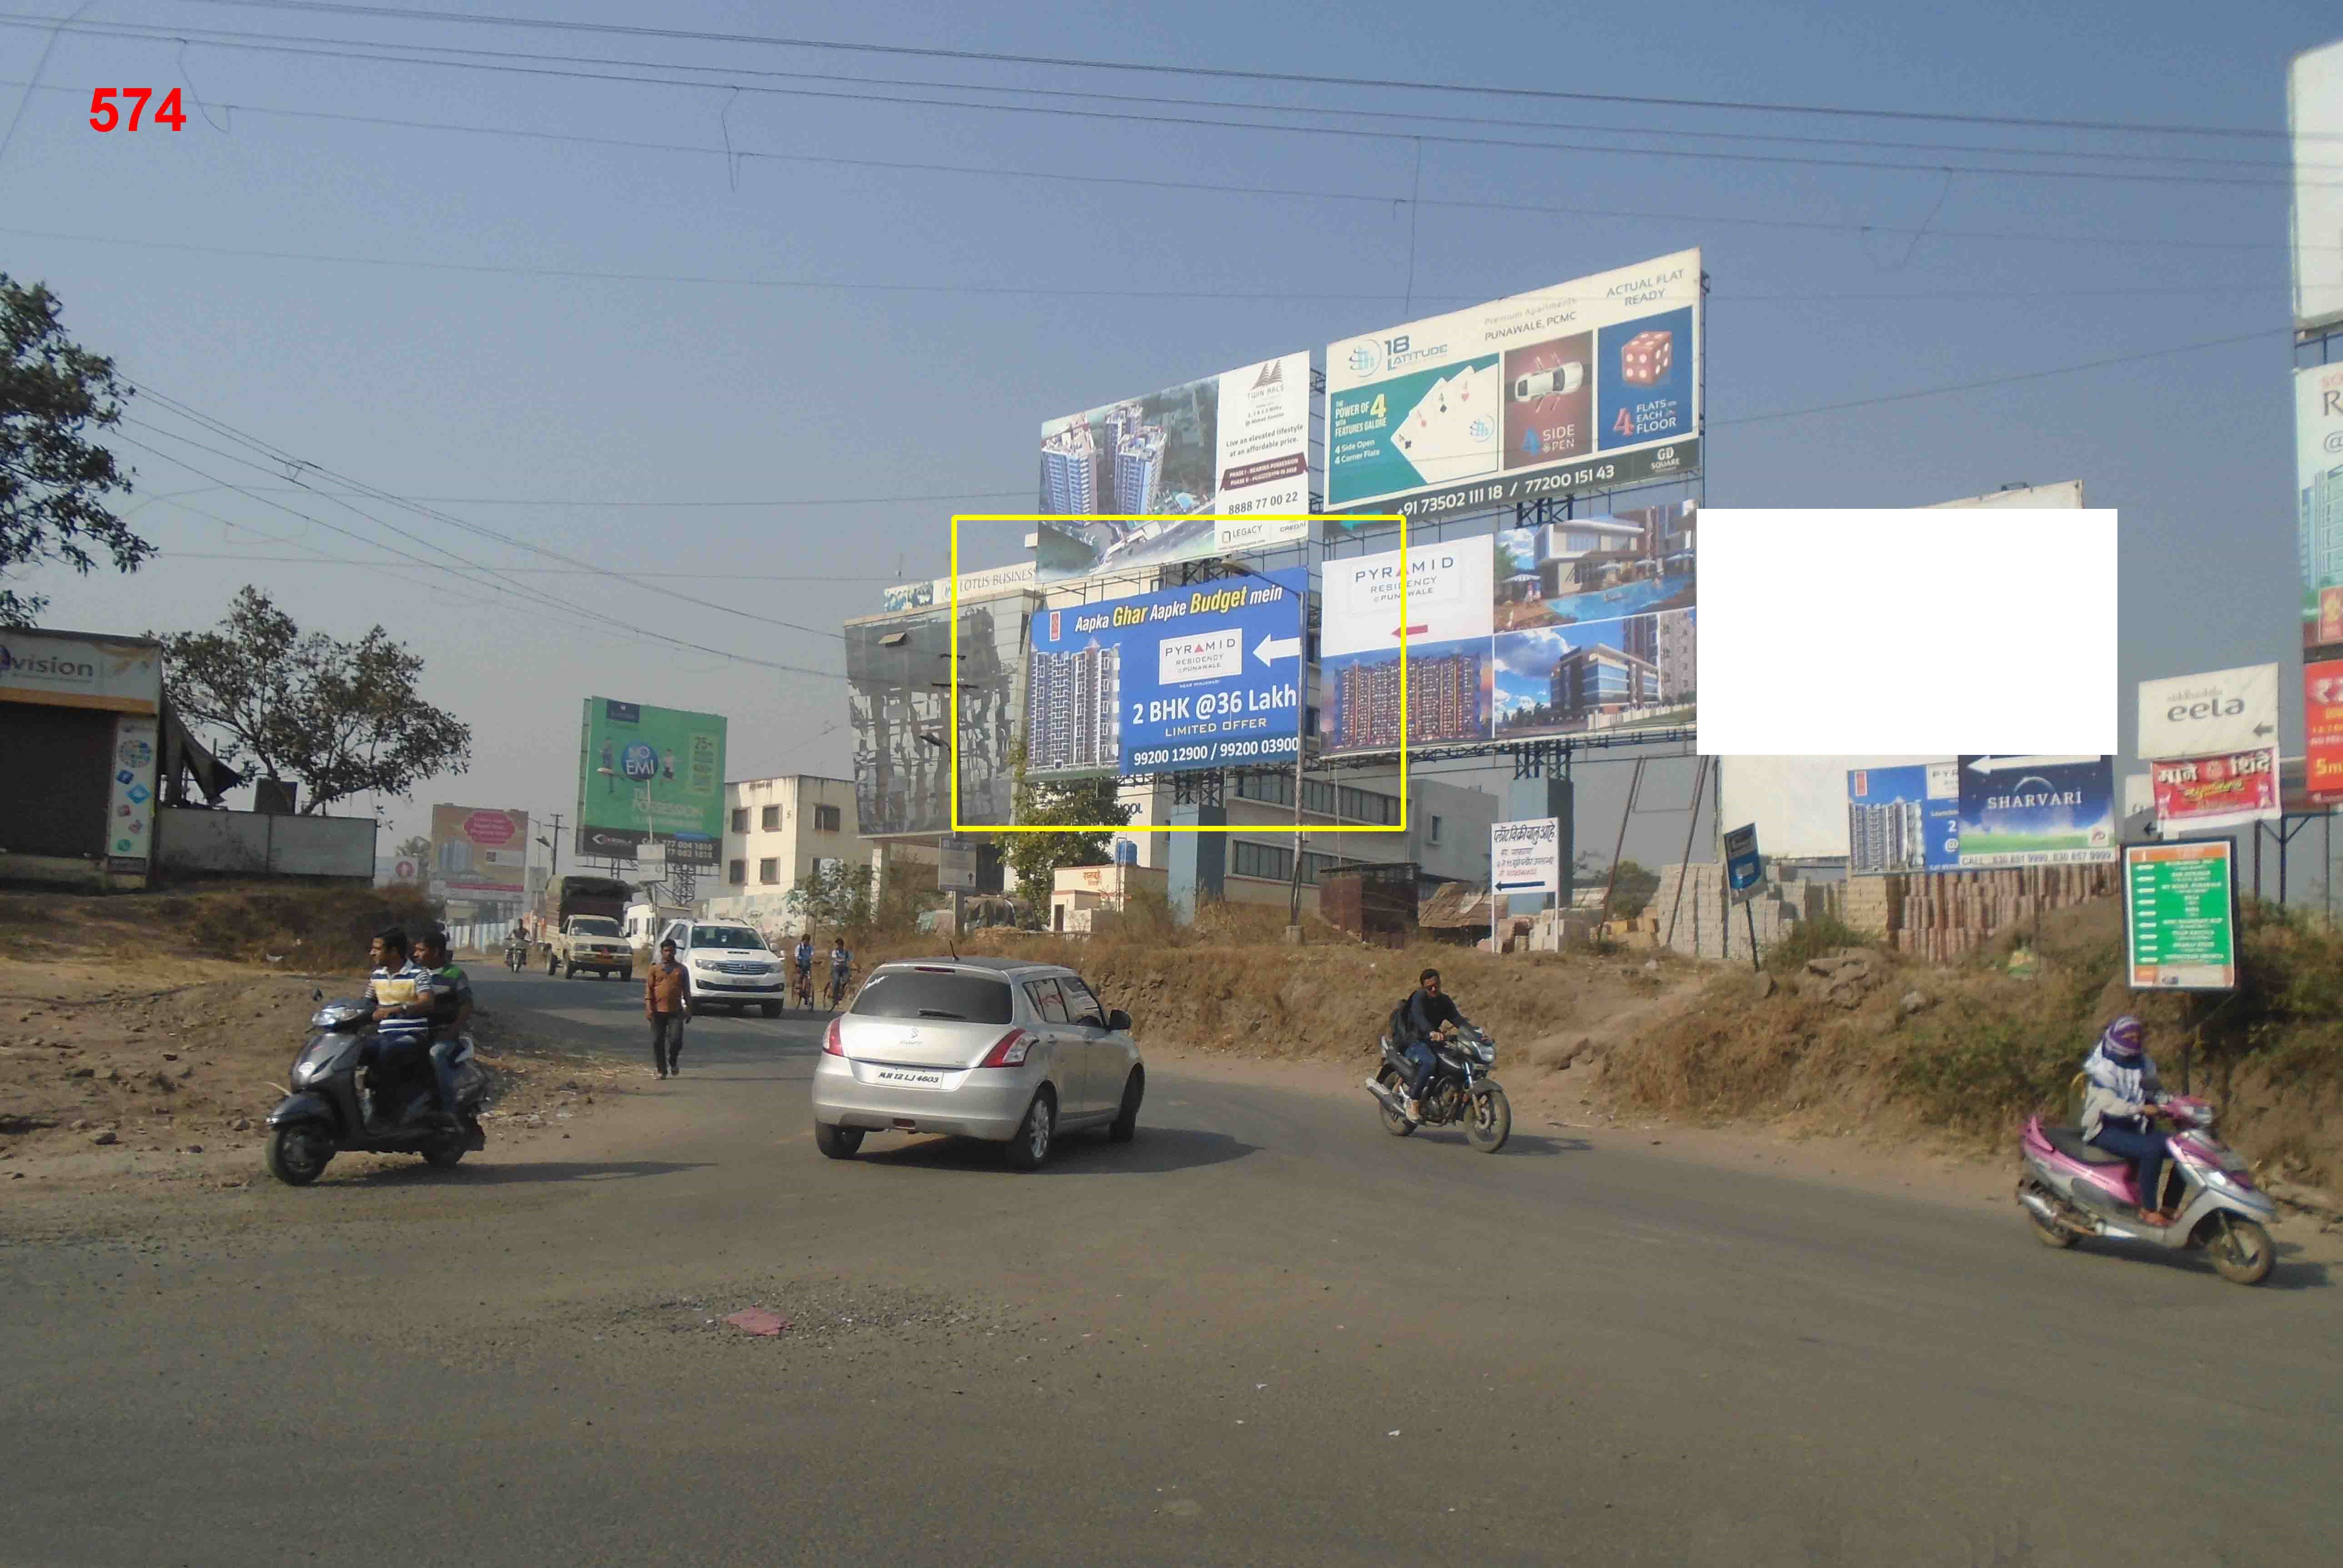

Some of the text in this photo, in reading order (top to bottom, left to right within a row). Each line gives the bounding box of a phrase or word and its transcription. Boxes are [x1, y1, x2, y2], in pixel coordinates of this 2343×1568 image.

[1606, 269, 1685, 298] ACTUAL FLAT
[1524, 297, 1576, 316] Apartments
[1624, 288, 1666, 307] READY
[1485, 311, 1577, 341] PUNAWALE, PCMC
[1384, 335, 1410, 356] 18
[1387, 344, 1448, 371] LATITUDE
[1335, 393, 1387, 418] POWER OF 4
[1613, 407, 1634, 437] 4
[1637, 399, 1666, 412] FLATS
[1637, 411, 1663, 422] EACH
[1637, 417, 1677, 434] FLOOR
[1249, 431, 1275, 442] elevated
[1276, 423, 1303, 435] lifestyle
[1335, 417, 1387, 437] FEATURES GALORE
[1247, 442, 1279, 453] affordable
[1280, 437, 1299, 448] price.
[1335, 440, 1375, 454] 4 Side Open
[1521, 424, 1576, 457] 4 SIDE
[1270, 458, 1299, 468] POSSESSION
[1335, 456, 1341, 465] 4
[1341, 453, 1363, 463] Corner
[1657, 447, 1674, 461] GD
[1651, 458, 1680, 470] SQUARE
[1397, 502, 1418, 517] +91
[1421, 492, 1465, 513] 73502
[1469, 488, 1484, 503] 111
[1488, 485, 1503, 500] 18
[1525, 473, 1571, 493] 77200
[1574, 469, 1593, 485] 151
[1596, 464, 1615, 480] 43
[1228, 491, 1298, 514] 8888 77 00 22
[1233, 525, 1262, 538] LEGACY
[1355, 556, 1454, 583] PYRAMID
[960, 576, 990, 592] LOTUS
[1370, 575, 1438, 593] RESIENCY
[1373, 587, 1434, 602] PUNWALE
[1075, 584, 1283, 633] Aapka Ghar Aapke Budget mein
[1165, 638, 1236, 658] PYRAMID
[1176, 653, 1224, 666] RESIDENCY
[1132, 683, 1297, 724] 2 BHK @36 Lakh
[2167, 698, 2245, 722] eela
[1165, 717, 1267, 738] LIMITED OFFER
[1134, 749, 1169, 766] 99200
[1172, 745, 1208, 762] 12900
[1220, 741, 1258, 757] 99200
[1261, 736, 1299, 754] 03900
[625, 759, 655, 775] EMI
[1987, 790, 2082, 809] SHARVARI
[1948, 820, 1957, 833] 2
[916, 1075, 940, 1083] 4603
